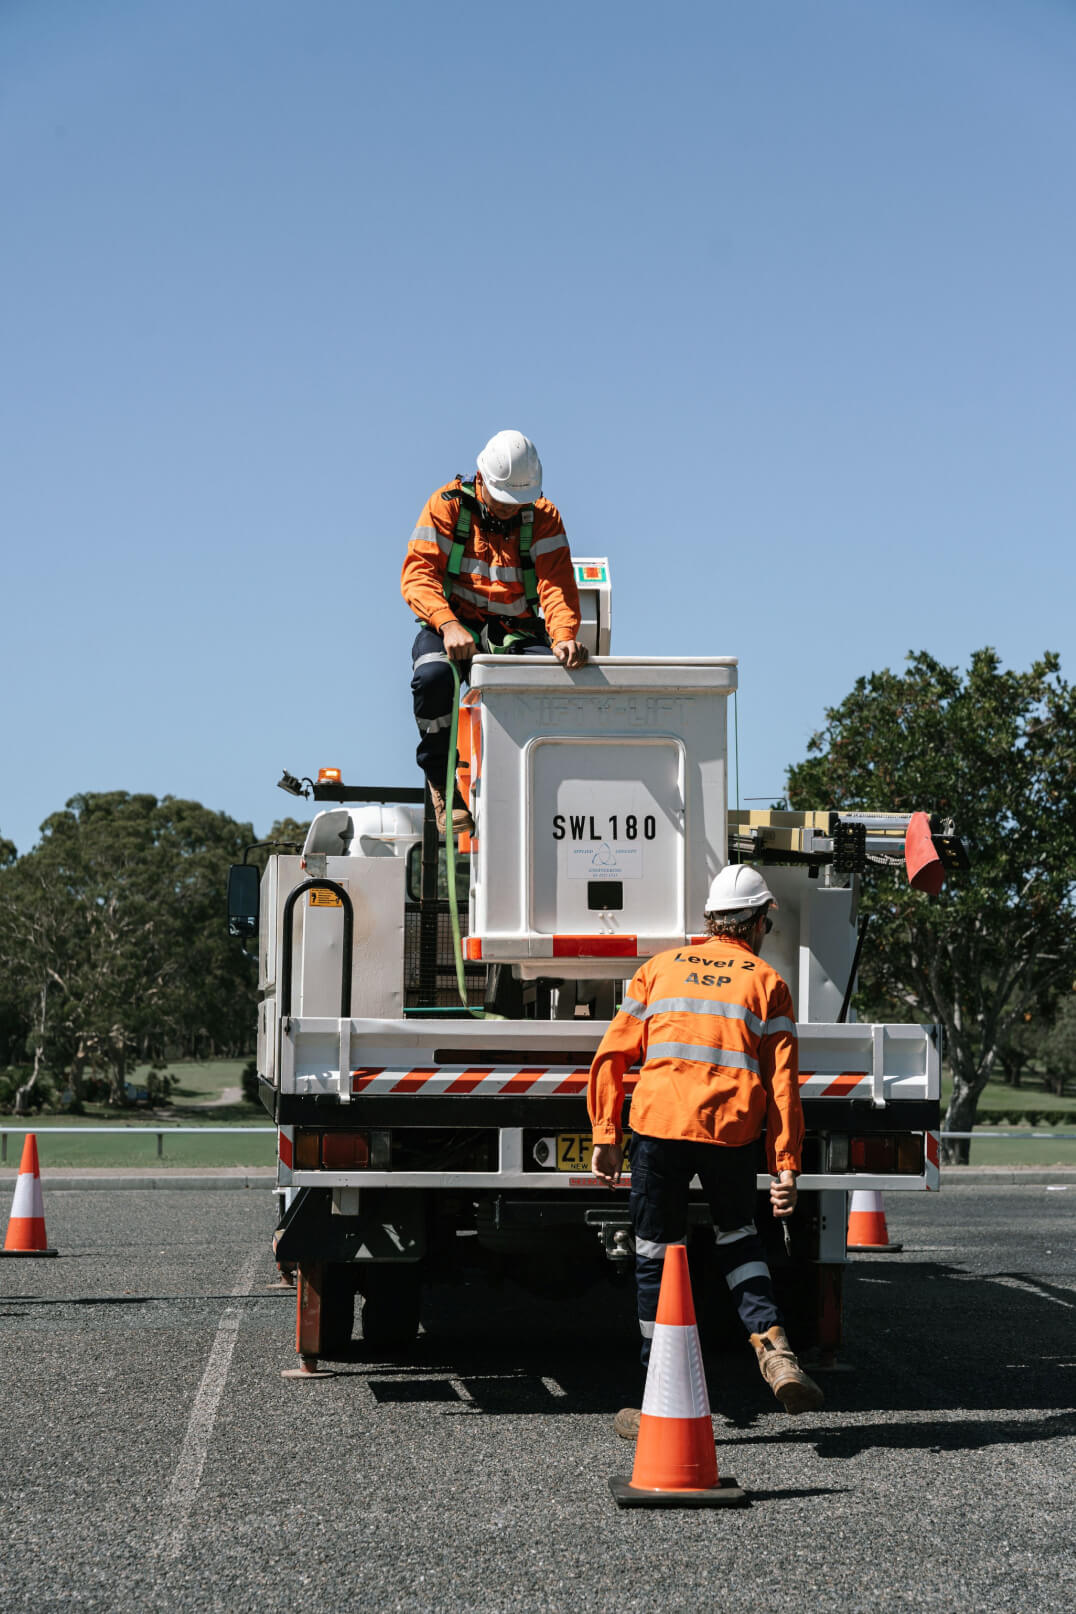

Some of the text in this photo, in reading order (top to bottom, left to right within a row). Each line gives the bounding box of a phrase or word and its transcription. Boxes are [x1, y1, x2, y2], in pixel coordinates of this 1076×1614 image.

[552, 814, 656, 841] SWL 180
[674, 953, 756, 971] Level 2
[685, 972, 731, 987] ASP
